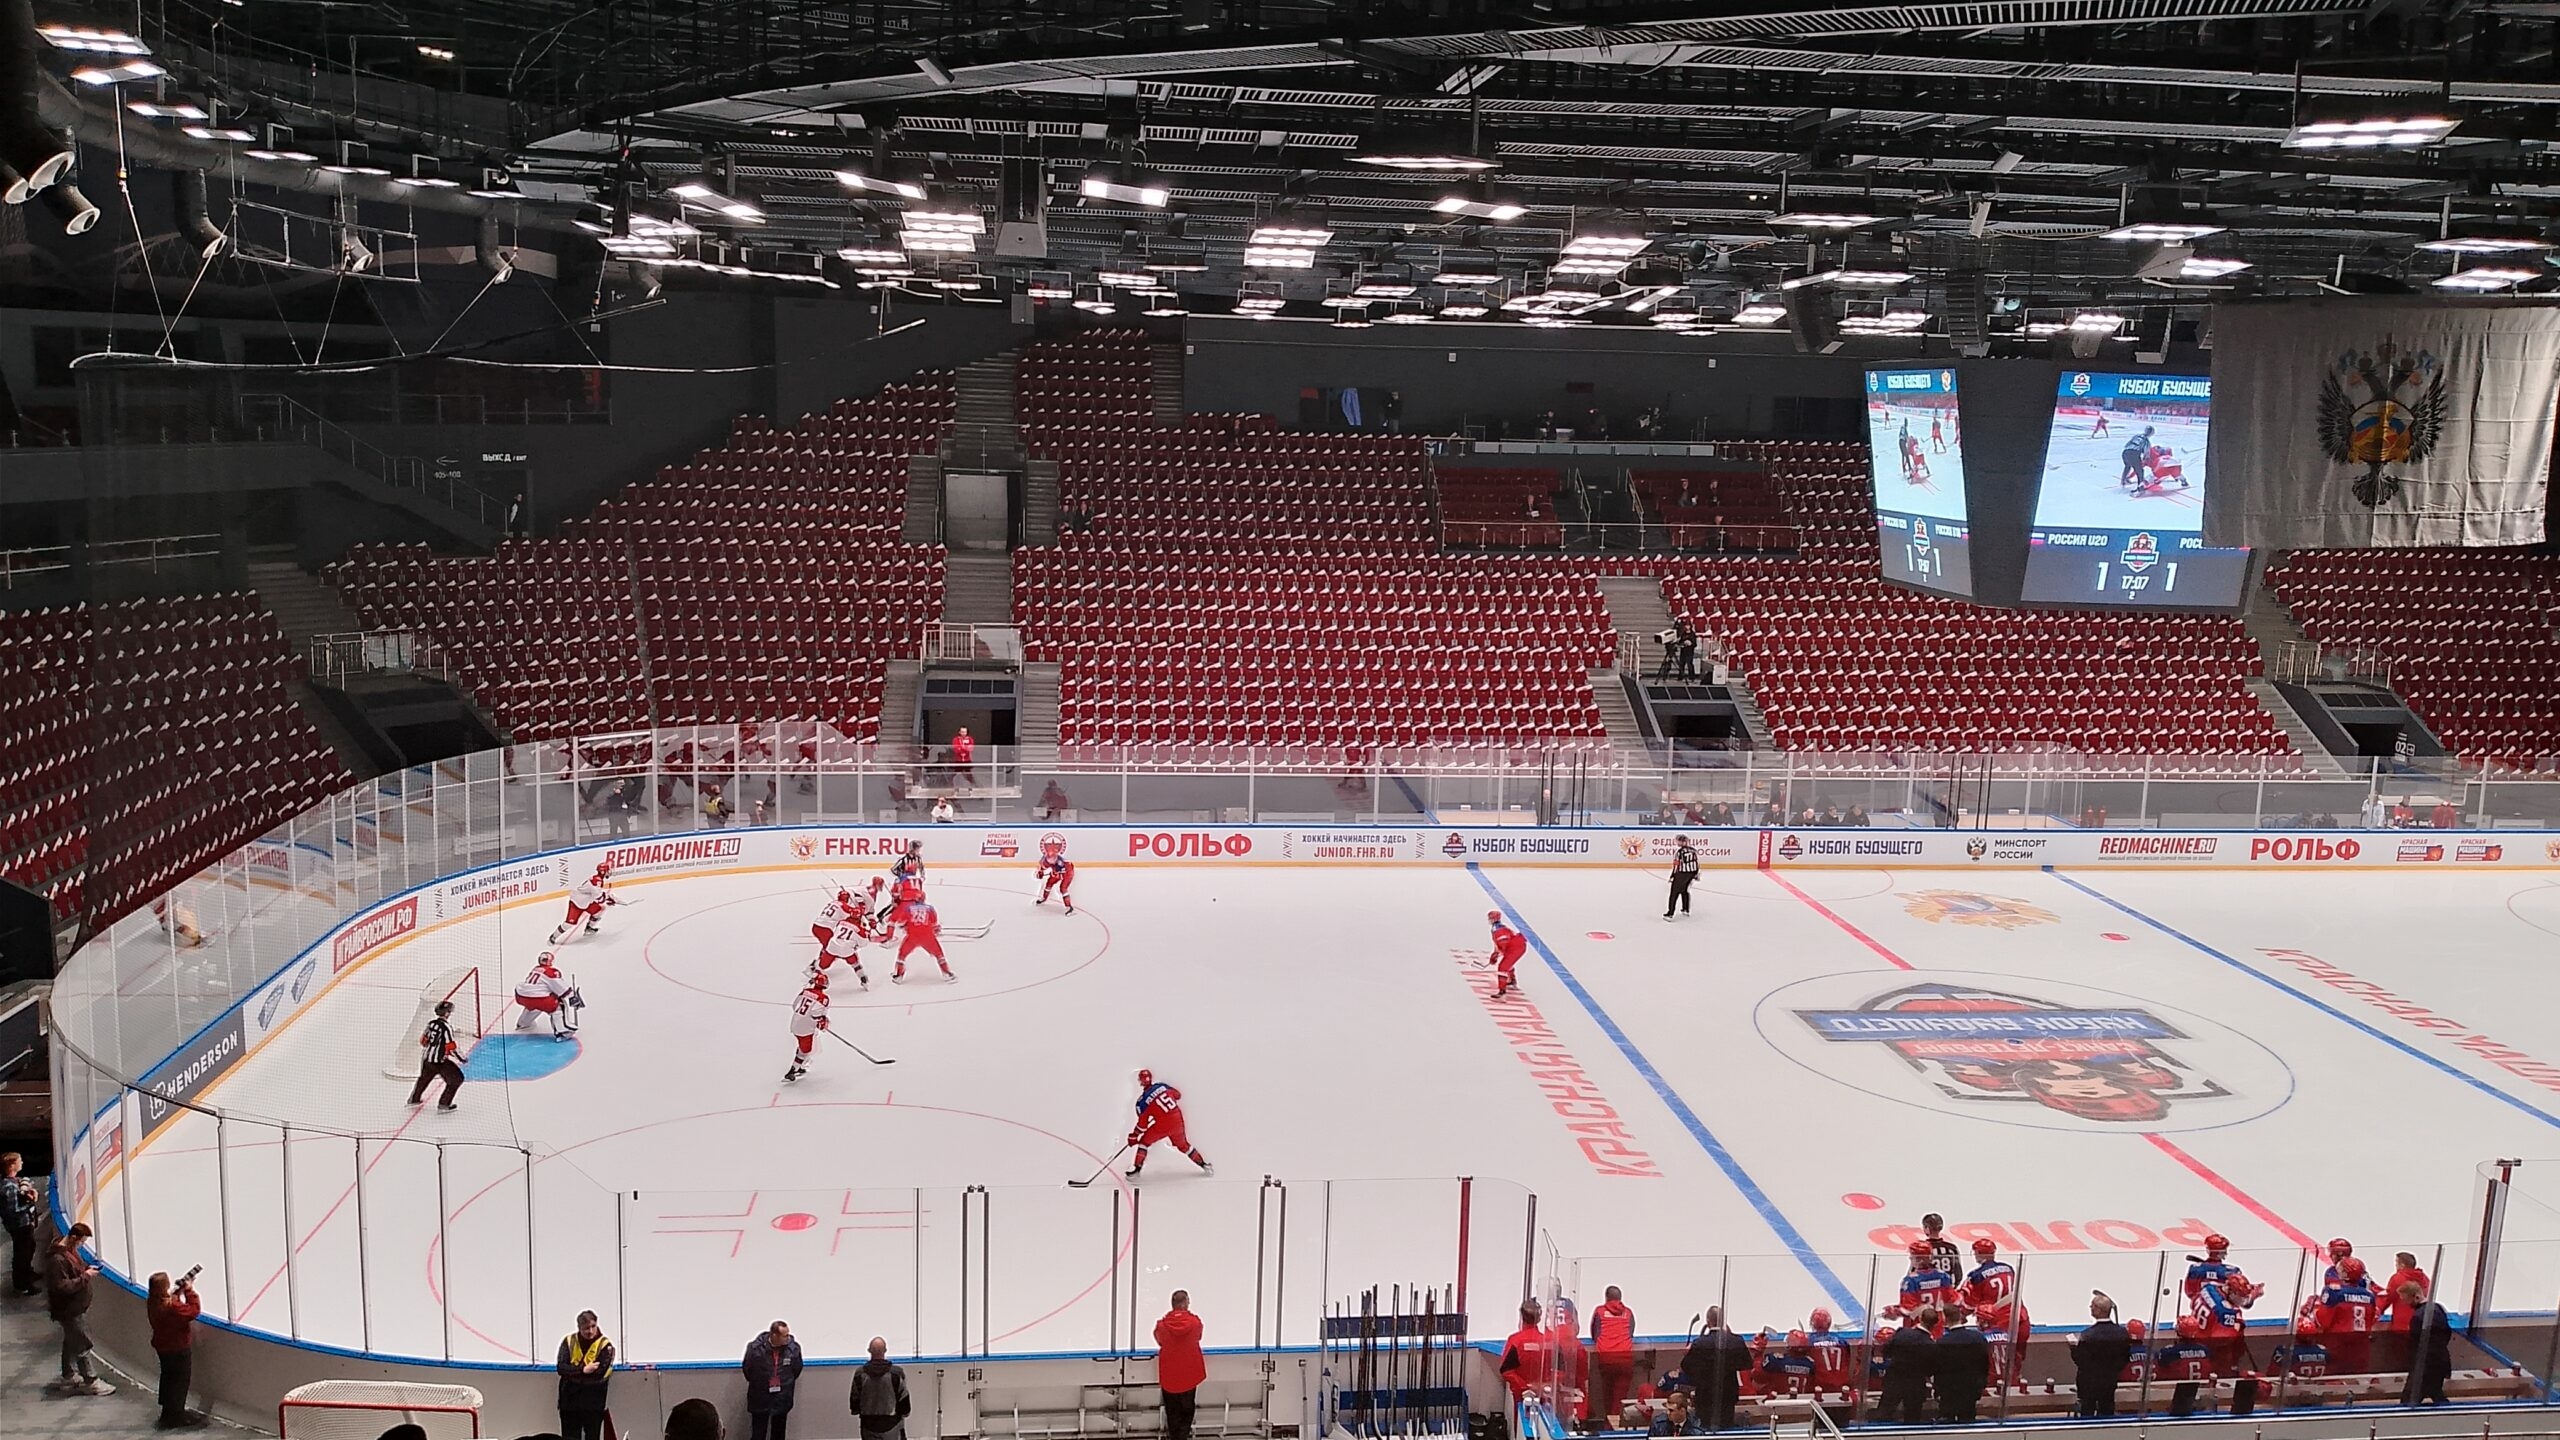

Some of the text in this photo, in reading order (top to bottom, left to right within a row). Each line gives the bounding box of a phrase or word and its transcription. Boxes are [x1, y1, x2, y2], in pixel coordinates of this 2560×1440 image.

[2119, 378, 2212, 398] КУБОК БУДУЩЕ
[2048, 533, 2108, 546] РОССИЯ U20
[1906, 544, 1914, 572] 1
[1934, 548, 1942, 577] 1
[2097, 562, 2110, 591] 1
[2122, 576, 2150, 590] 17:07
[2165, 562, 2178, 592] 1
[2128, 591, 2136, 600] 2
[2394, 741, 2406, 754] 02
[825, 838, 909, 856] FHR.RU
[1129, 833, 1252, 857] РОЛЬФ
[1302, 832, 1406, 844] ХОККЕЙ НАЧИНАЕТСЯ ЗДЕСЬ
[1473, 838, 1516, 852] КУБОК
[1520, 838, 1589, 854] БУДУЩЕГО
[1761, 832, 1770, 862] РОЛЬФ
[1994, 839, 2046, 848] МИНСПОРТ
[2100, 837, 2218, 854] REDMACHINE.RU
[605, 838, 742, 869] REDMACHINE.RU
[1314, 846, 1394, 858] JUNIOR.FHR.RU
[1698, 848, 1731, 856] ОССИИ
[1809, 840, 1850, 855] КУБОК
[1855, 840, 1922, 856] БУДУЩЕГО
[1994, 850, 2033, 859] РОССИИ
[2250, 838, 2360, 861] РОЛЬФ
[450, 864, 550, 896] ХОККЕЙ НАЧИНАЕТСЯ ЗДЕСЬ
[462, 879, 538, 910] JUNIOR.FHR.RU
[837, 926, 852, 940] 21
[2254, 947, 2467, 1029] КРАСНАЯ
[1829, 1016, 2148, 1032] КУБОК БУДУЩЕГО
[166, 1030, 238, 1098] HENDERSON
[1156, 1093, 1176, 1112] 15
[1516, 1052, 1665, 1177] КРАСНАЯ
[1931, 1258, 1950, 1272] 38
[2224, 1314, 2236, 1326] 26
[2353, 1306, 2366, 1332] 8
[1821, 1348, 1842, 1372] 17
